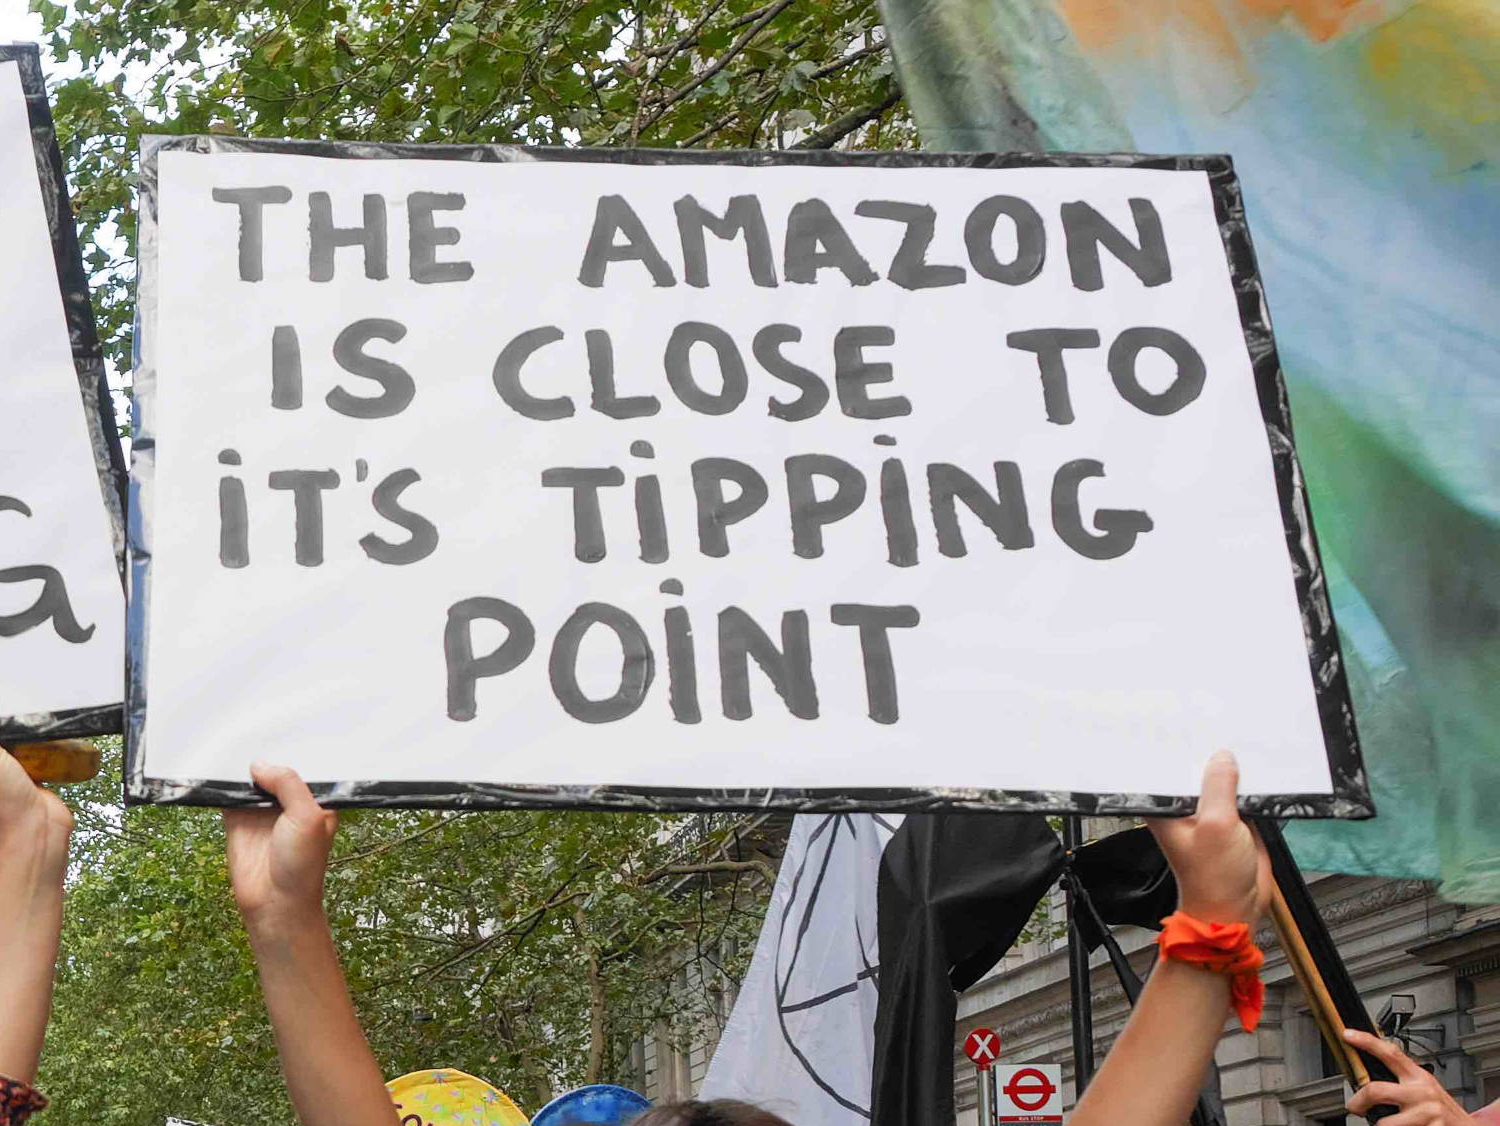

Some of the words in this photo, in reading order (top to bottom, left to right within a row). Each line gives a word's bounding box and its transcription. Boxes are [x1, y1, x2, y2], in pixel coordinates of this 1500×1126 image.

[211, 185, 476, 284] THE
[576, 193, 1174, 292] AMAZON
[269, 317, 417, 420] IS
[492, 320, 913, 422] CLOSE
[1005, 325, 1208, 426] TO
[971, 1033, 996, 1060] X
